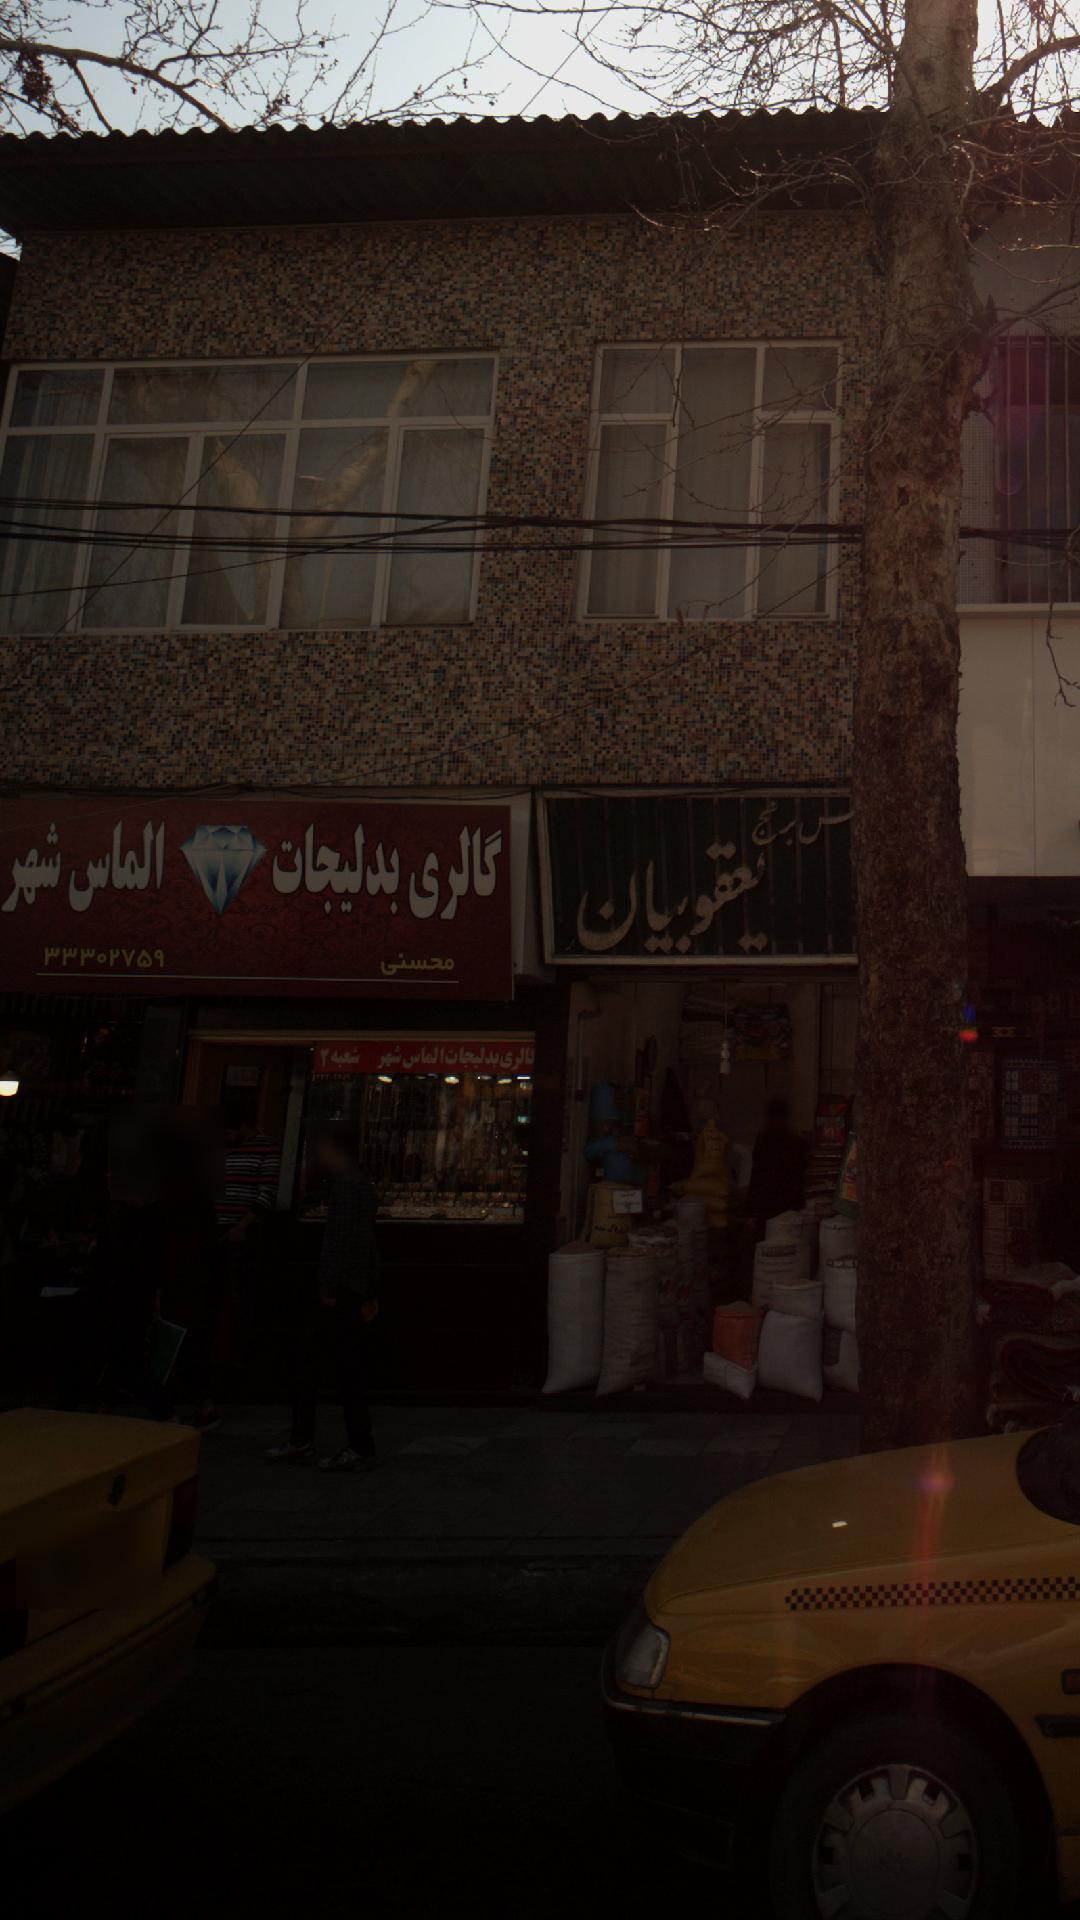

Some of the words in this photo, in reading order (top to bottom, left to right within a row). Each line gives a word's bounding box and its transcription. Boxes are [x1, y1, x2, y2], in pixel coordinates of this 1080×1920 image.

[0, 823, 62, 913] شهر
[68, 820, 166, 912] الماس
[272, 823, 400, 914] بدلیجات
[408, 825, 503, 921] گالری
[43, 946, 166, 969] ۳۳۳۰۲۷۵۹
[380, 953, 456, 978] محسنی
